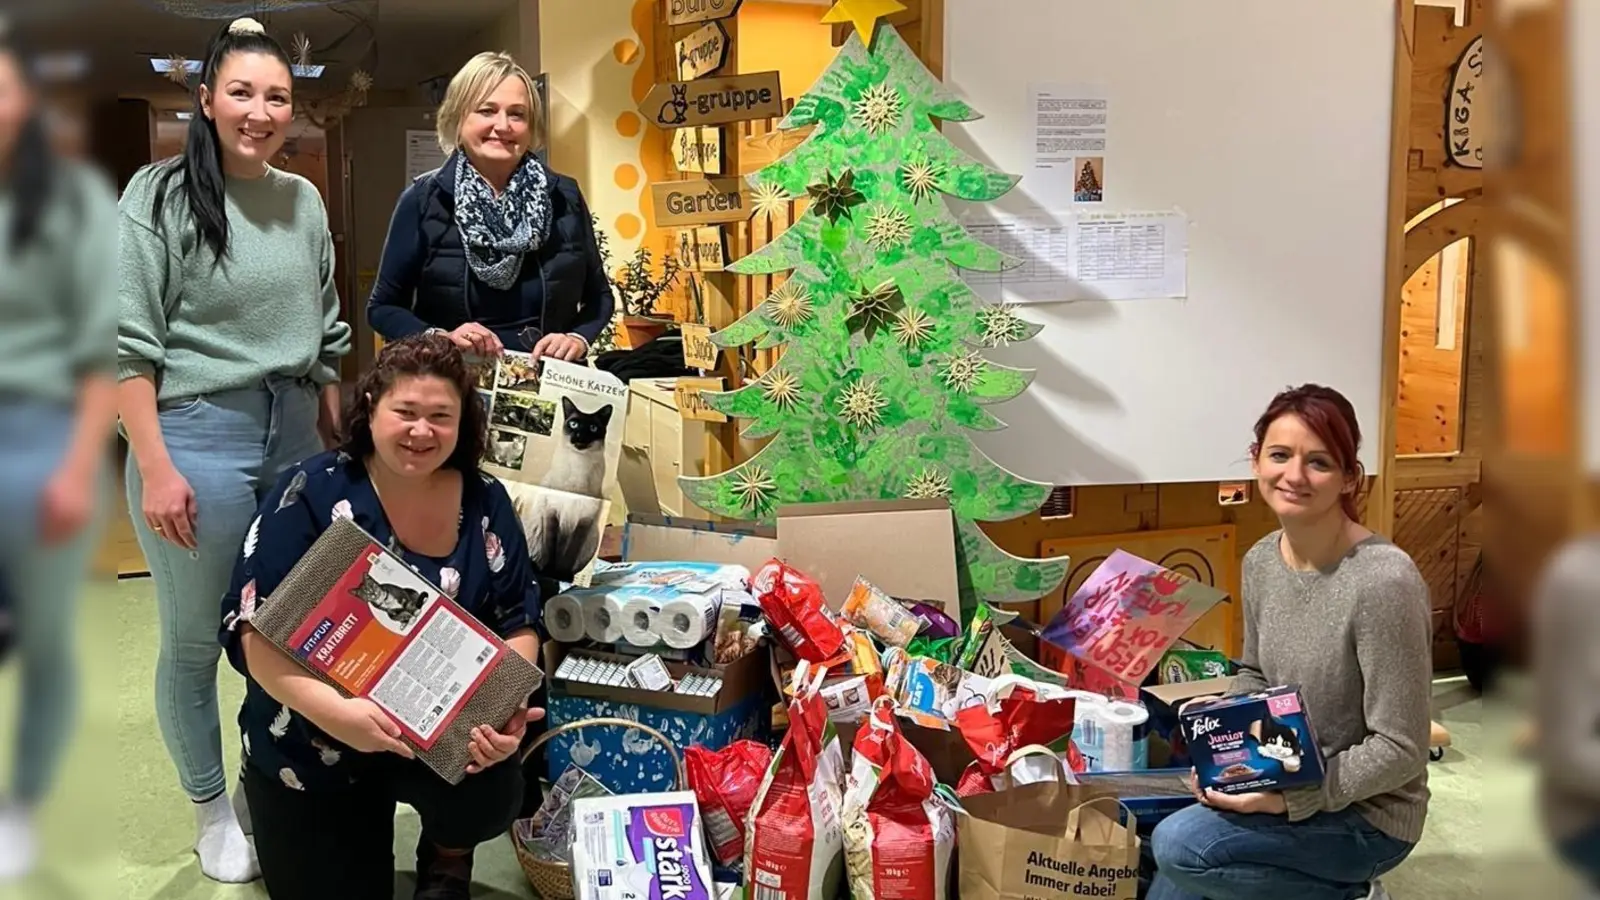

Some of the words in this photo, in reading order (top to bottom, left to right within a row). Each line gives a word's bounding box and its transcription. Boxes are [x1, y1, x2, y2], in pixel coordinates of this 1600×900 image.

[666, 190, 742, 214] Garten
[315, 612, 359, 662] KRATZBRETT
[1191, 717, 1221, 740] felix
[1208, 730, 1244, 745] Junior
[655, 837, 693, 900] stark
[1027, 851, 1085, 877] Aktuelle
[1025, 869, 1070, 892] Immer
[1073, 881, 1117, 897] dabei!
